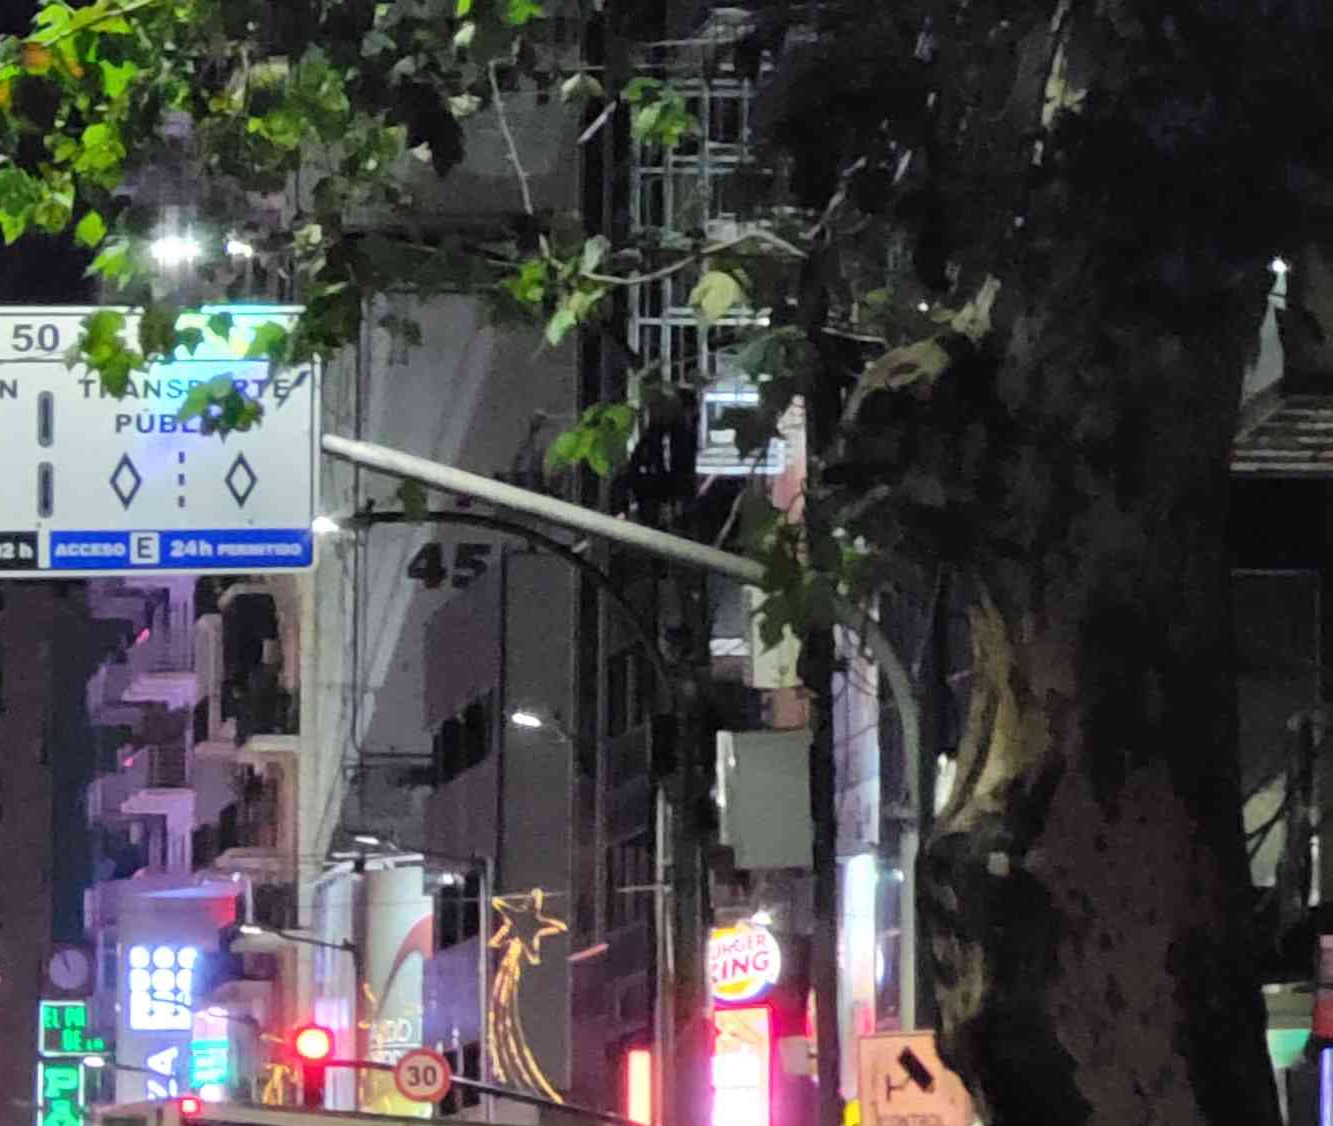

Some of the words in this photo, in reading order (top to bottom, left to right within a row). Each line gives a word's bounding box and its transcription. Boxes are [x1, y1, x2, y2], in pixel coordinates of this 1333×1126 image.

[11, 323, 59, 352] 50
[19, 543, 33, 559] h
[137, 537, 153, 559] E
[406, 1065, 438, 1087] 30
